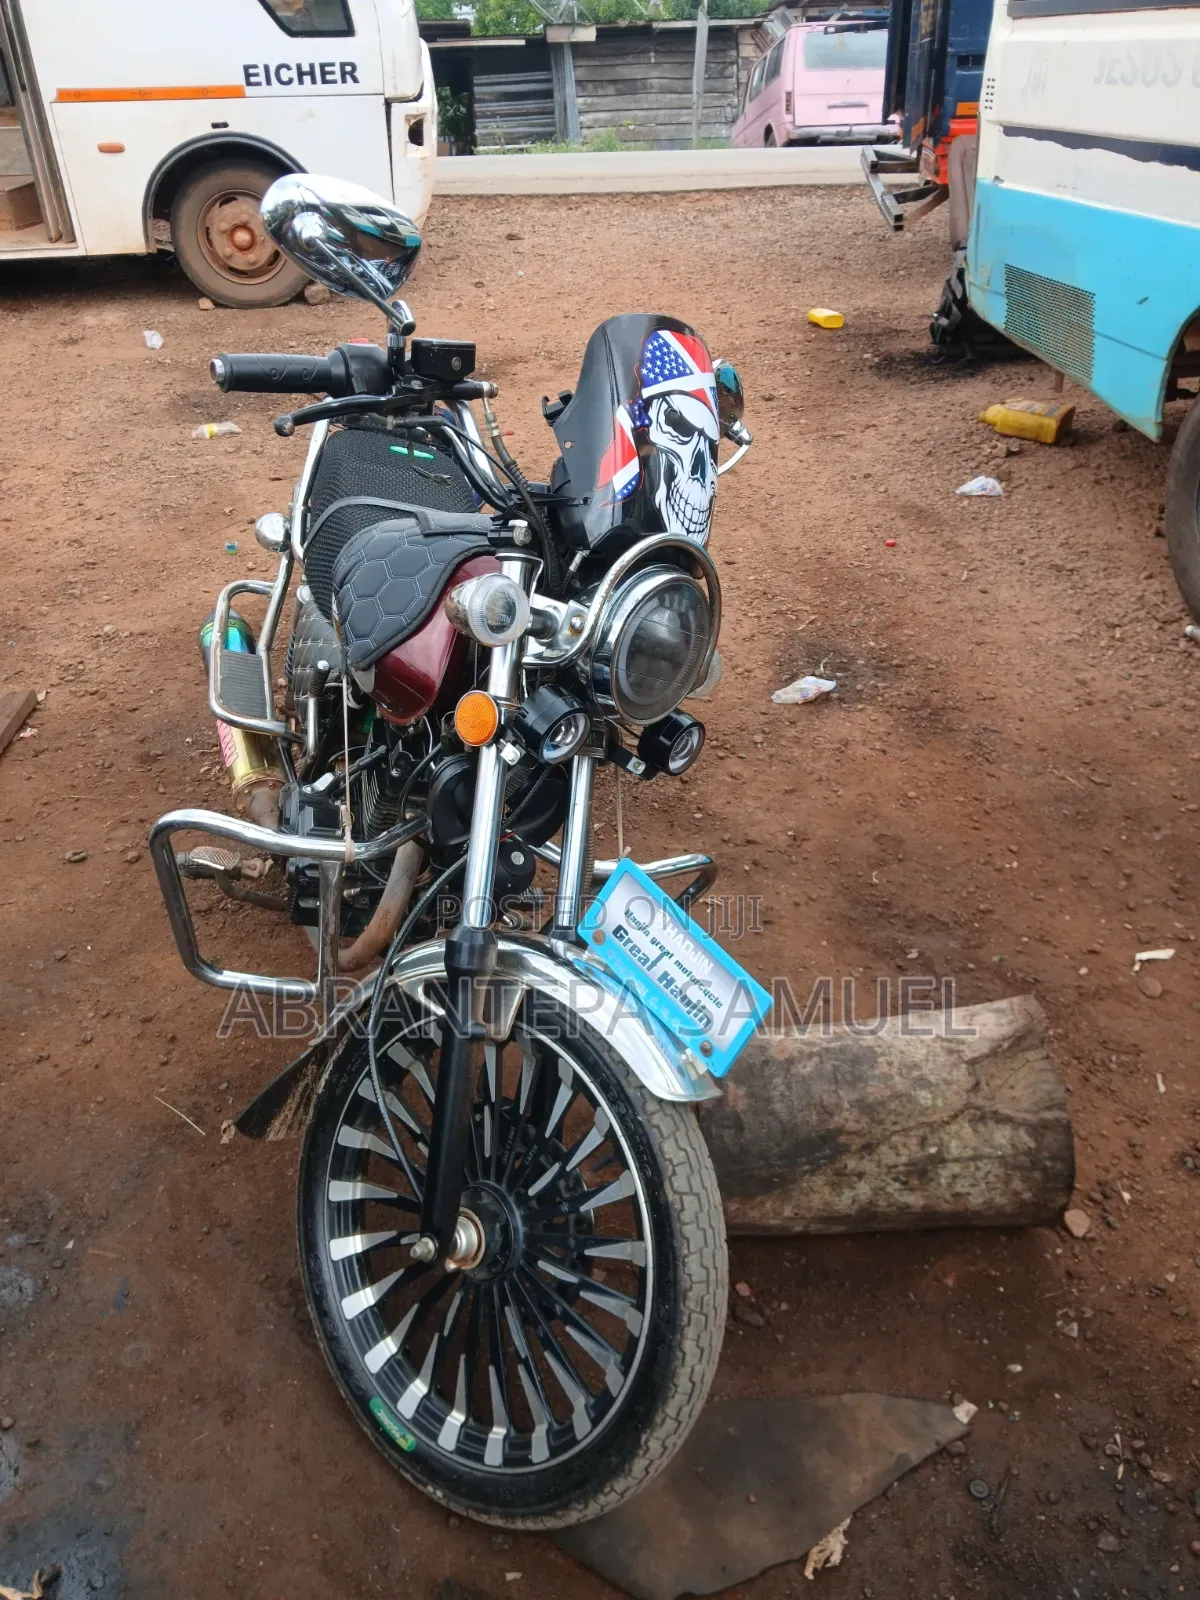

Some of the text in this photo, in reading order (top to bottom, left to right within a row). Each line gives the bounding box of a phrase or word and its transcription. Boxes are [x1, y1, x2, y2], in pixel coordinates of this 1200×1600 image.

[243, 61, 360, 87] EICHER
[612, 923, 665, 972] Great
[650, 936, 674, 960] great
[674, 959, 724, 1009] motorcycle
